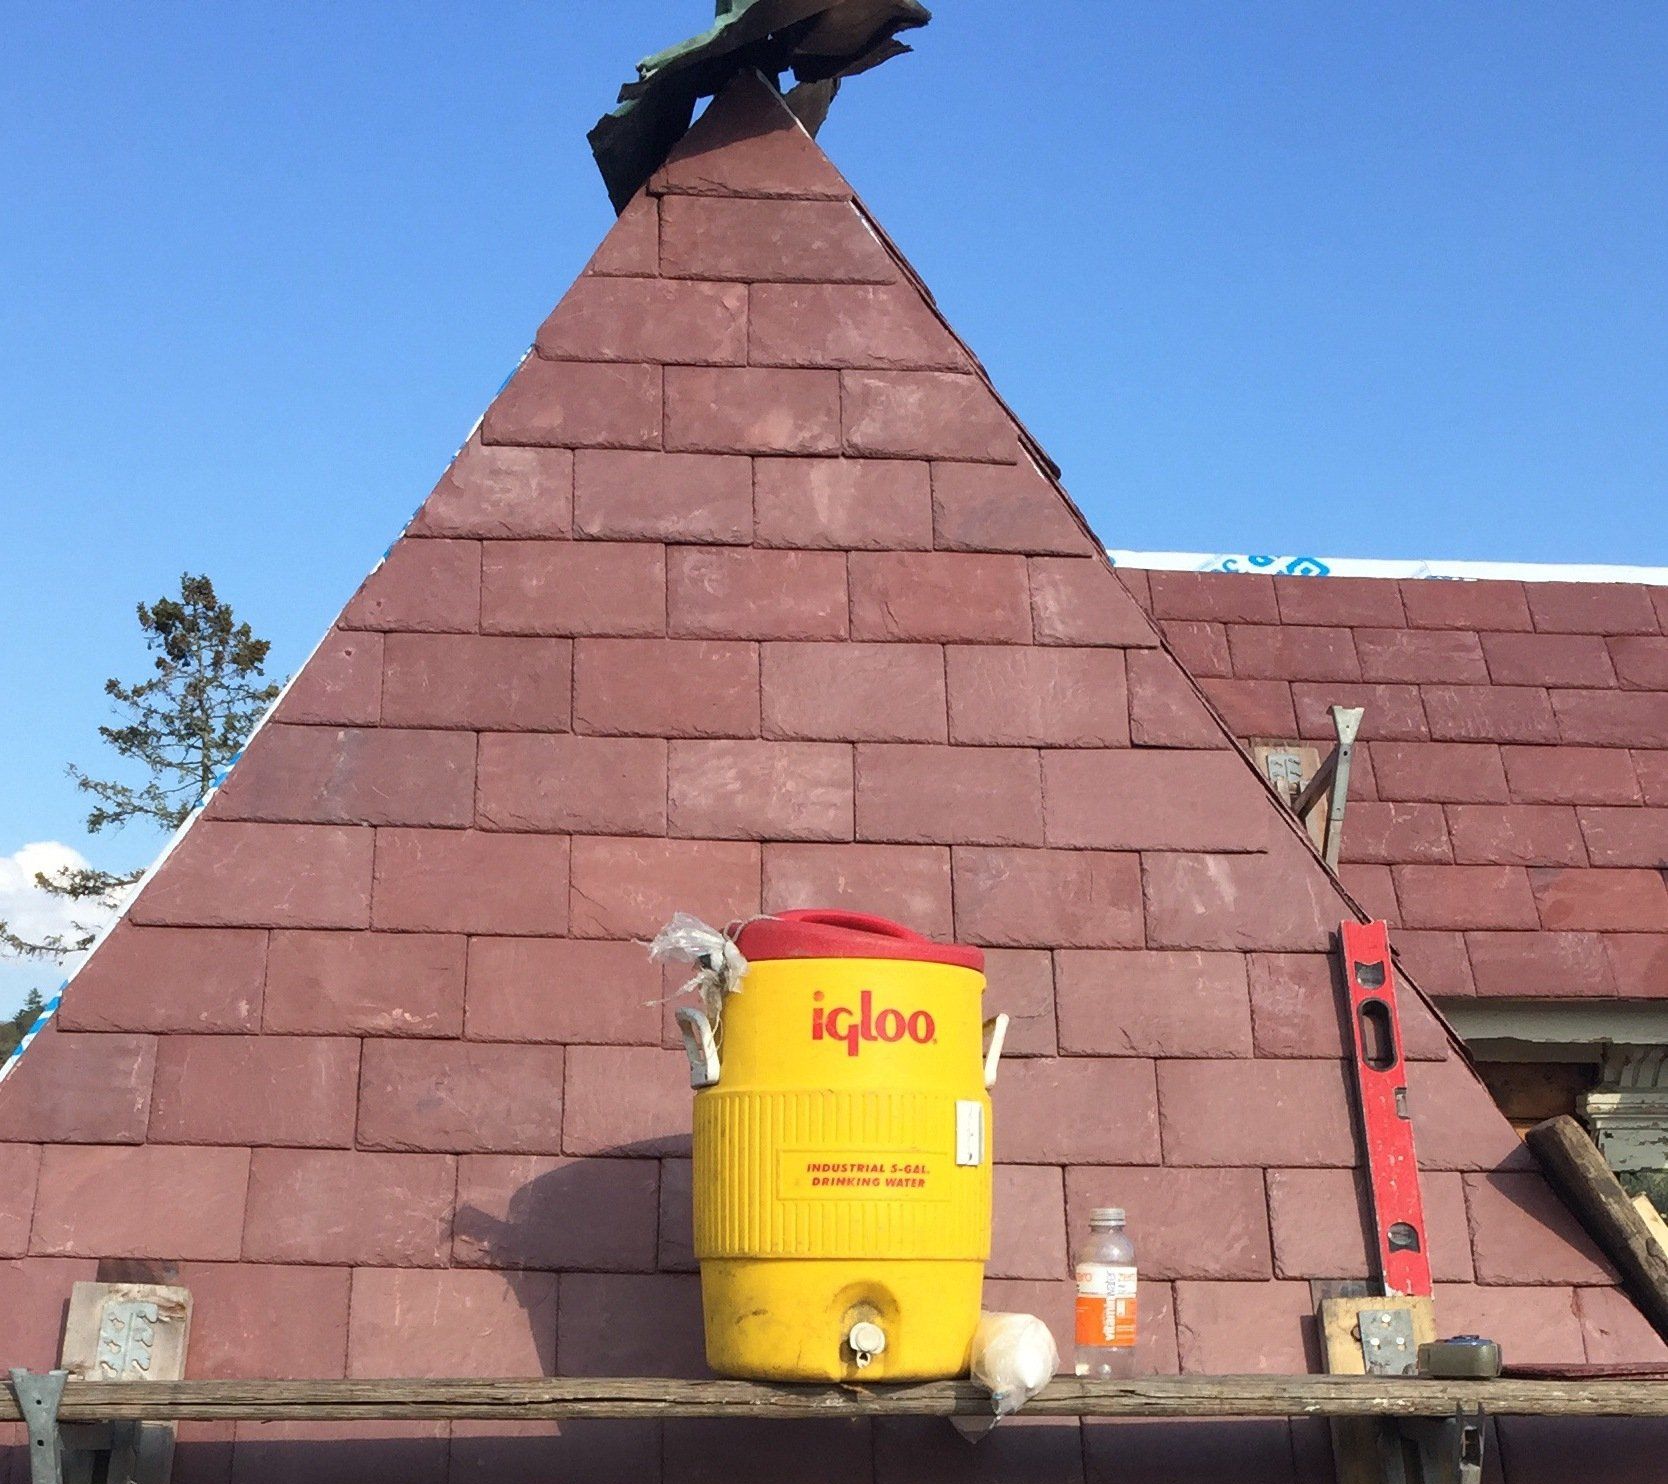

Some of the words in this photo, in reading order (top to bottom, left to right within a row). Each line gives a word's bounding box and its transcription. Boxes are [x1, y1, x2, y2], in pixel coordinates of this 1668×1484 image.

[812, 990, 935, 1056] igloo
[807, 1163, 886, 1173] INDUSTRIAL
[890, 1163, 930, 1174] 5-GAL.
[812, 1177, 881, 1187] DRINKING
[885, 1178, 926, 1188] WATER
